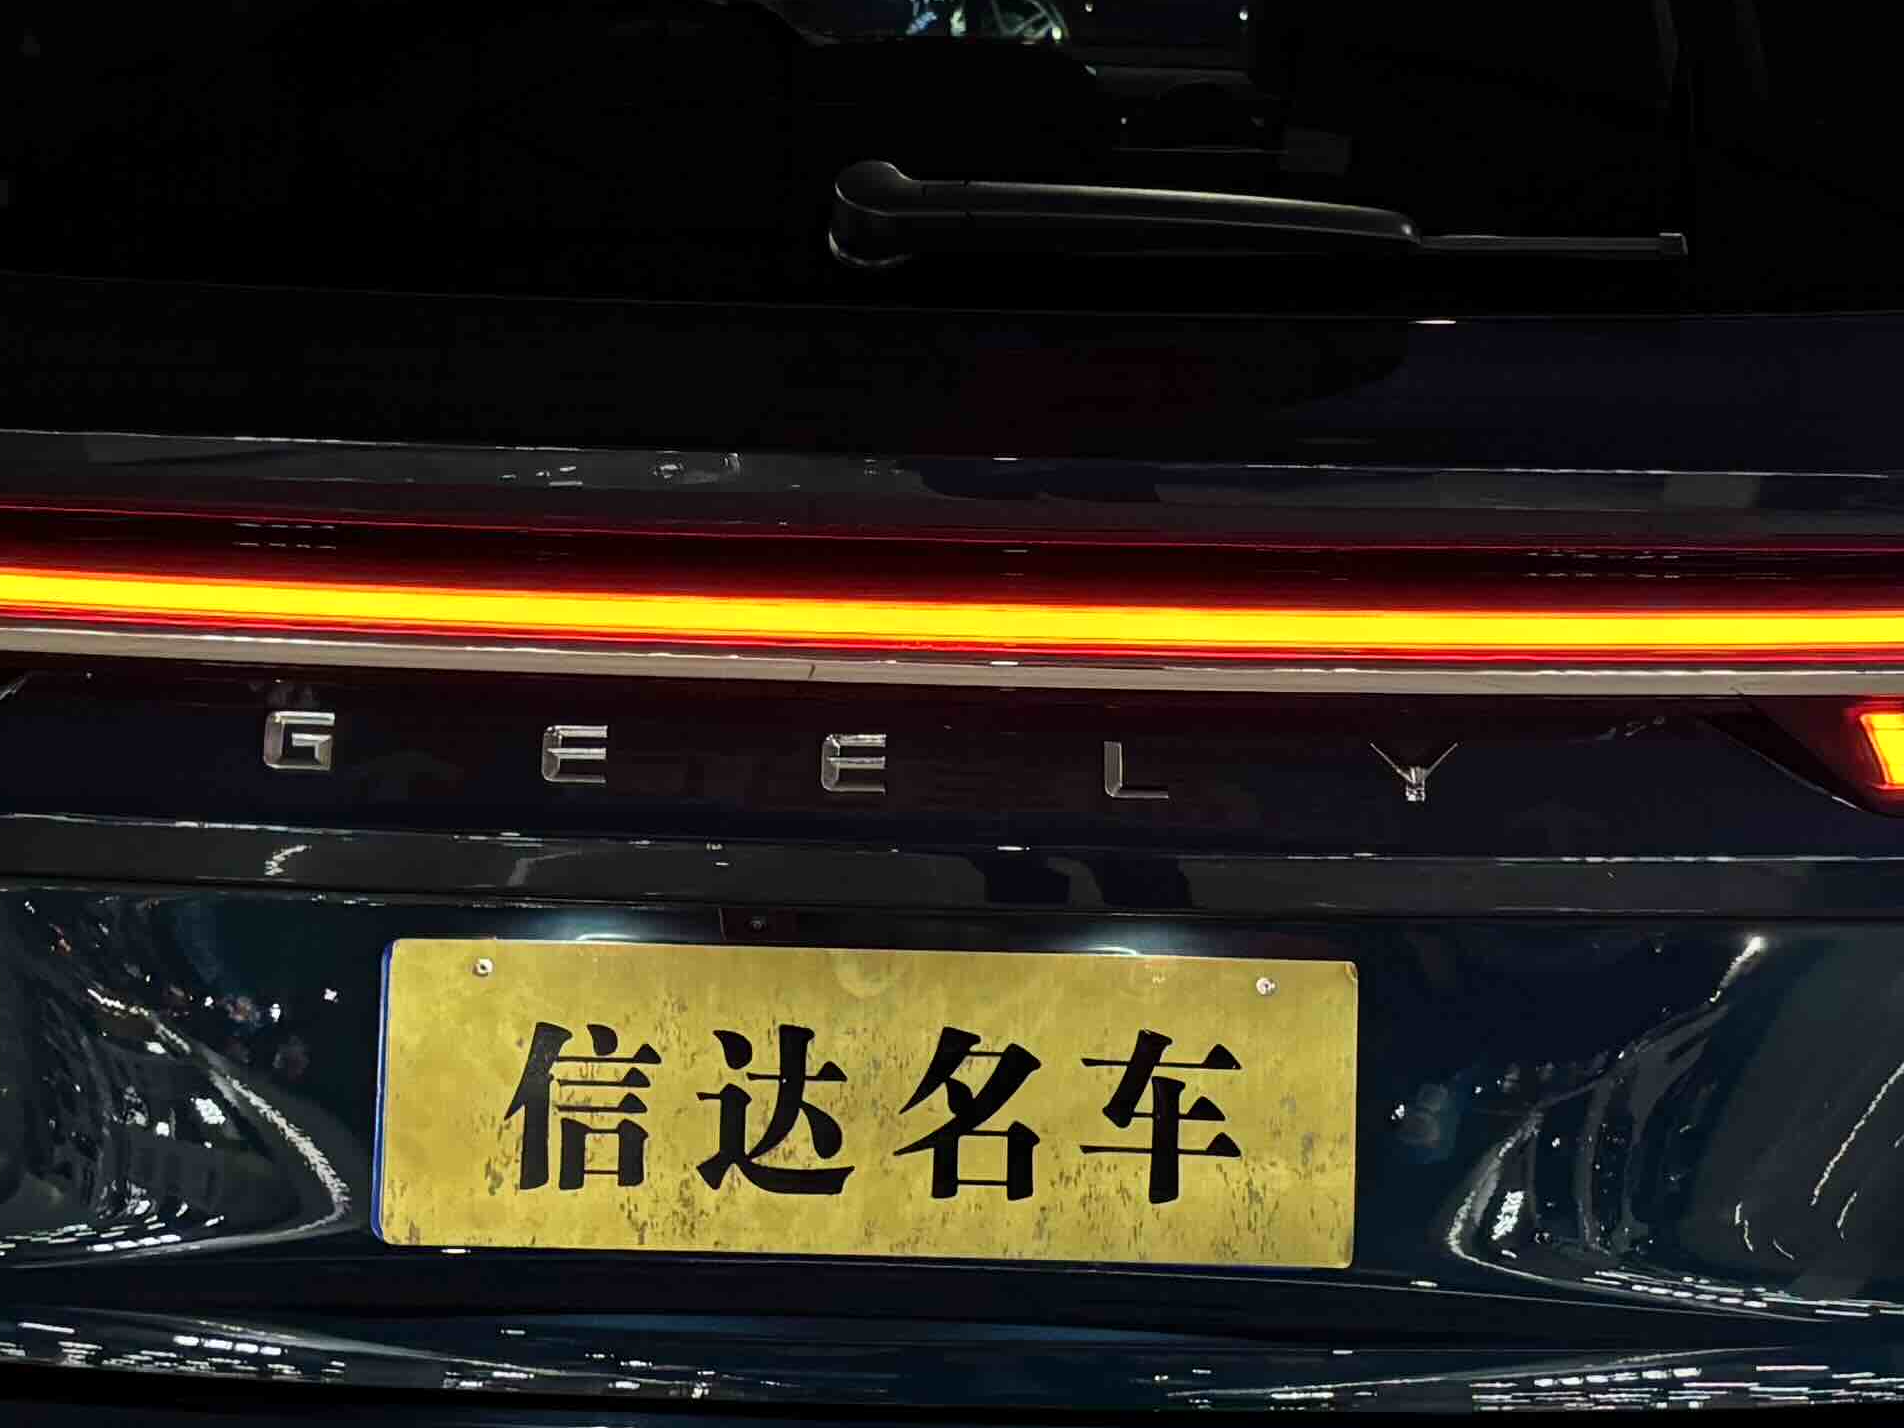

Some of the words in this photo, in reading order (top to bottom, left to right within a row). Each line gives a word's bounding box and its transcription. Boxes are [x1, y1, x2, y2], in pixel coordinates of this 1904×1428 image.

[262, 709, 1460, 803] GEELY
[502, 1019, 1243, 1206] 信达名车
